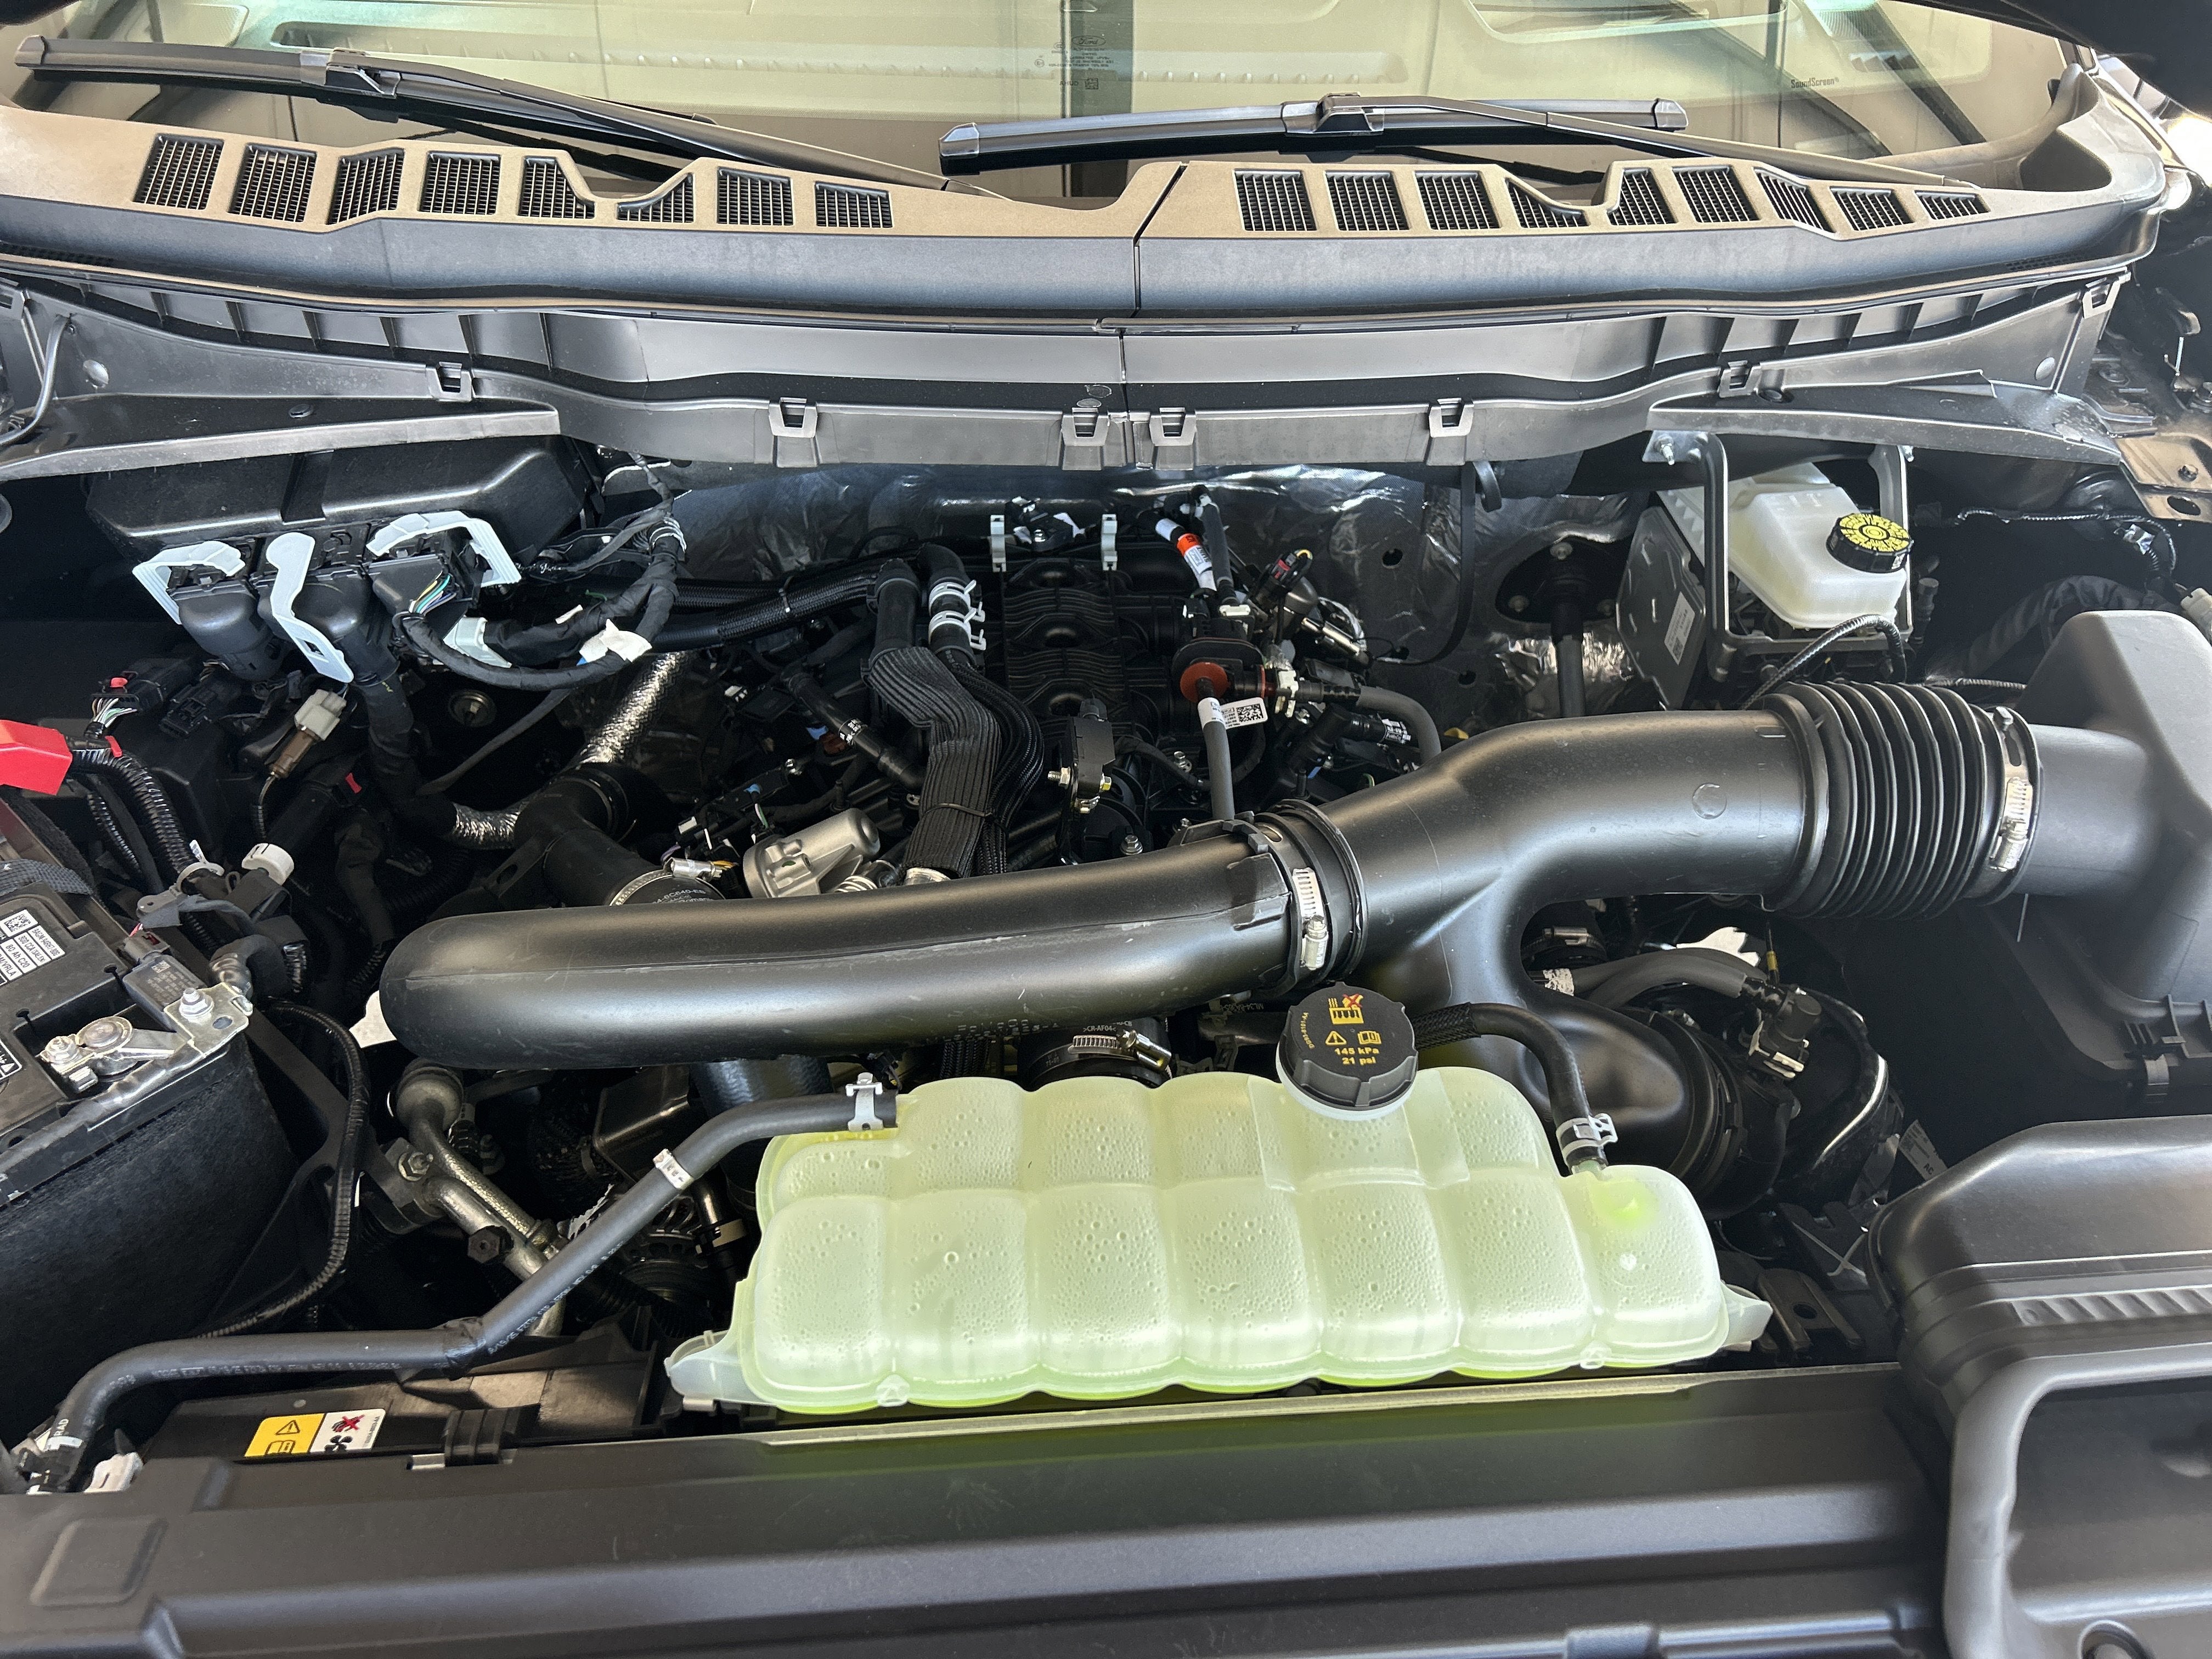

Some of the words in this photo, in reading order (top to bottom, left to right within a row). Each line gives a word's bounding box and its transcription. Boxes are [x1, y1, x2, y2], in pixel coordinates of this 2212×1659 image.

[0, 953, 17, 977] M/VRLA
[1334, 1047, 1355, 1056] 145
[1342, 1057, 1356, 1065] 21
[1359, 1057, 1377, 1065] psi
[53, 1418, 69, 1436] RAD
